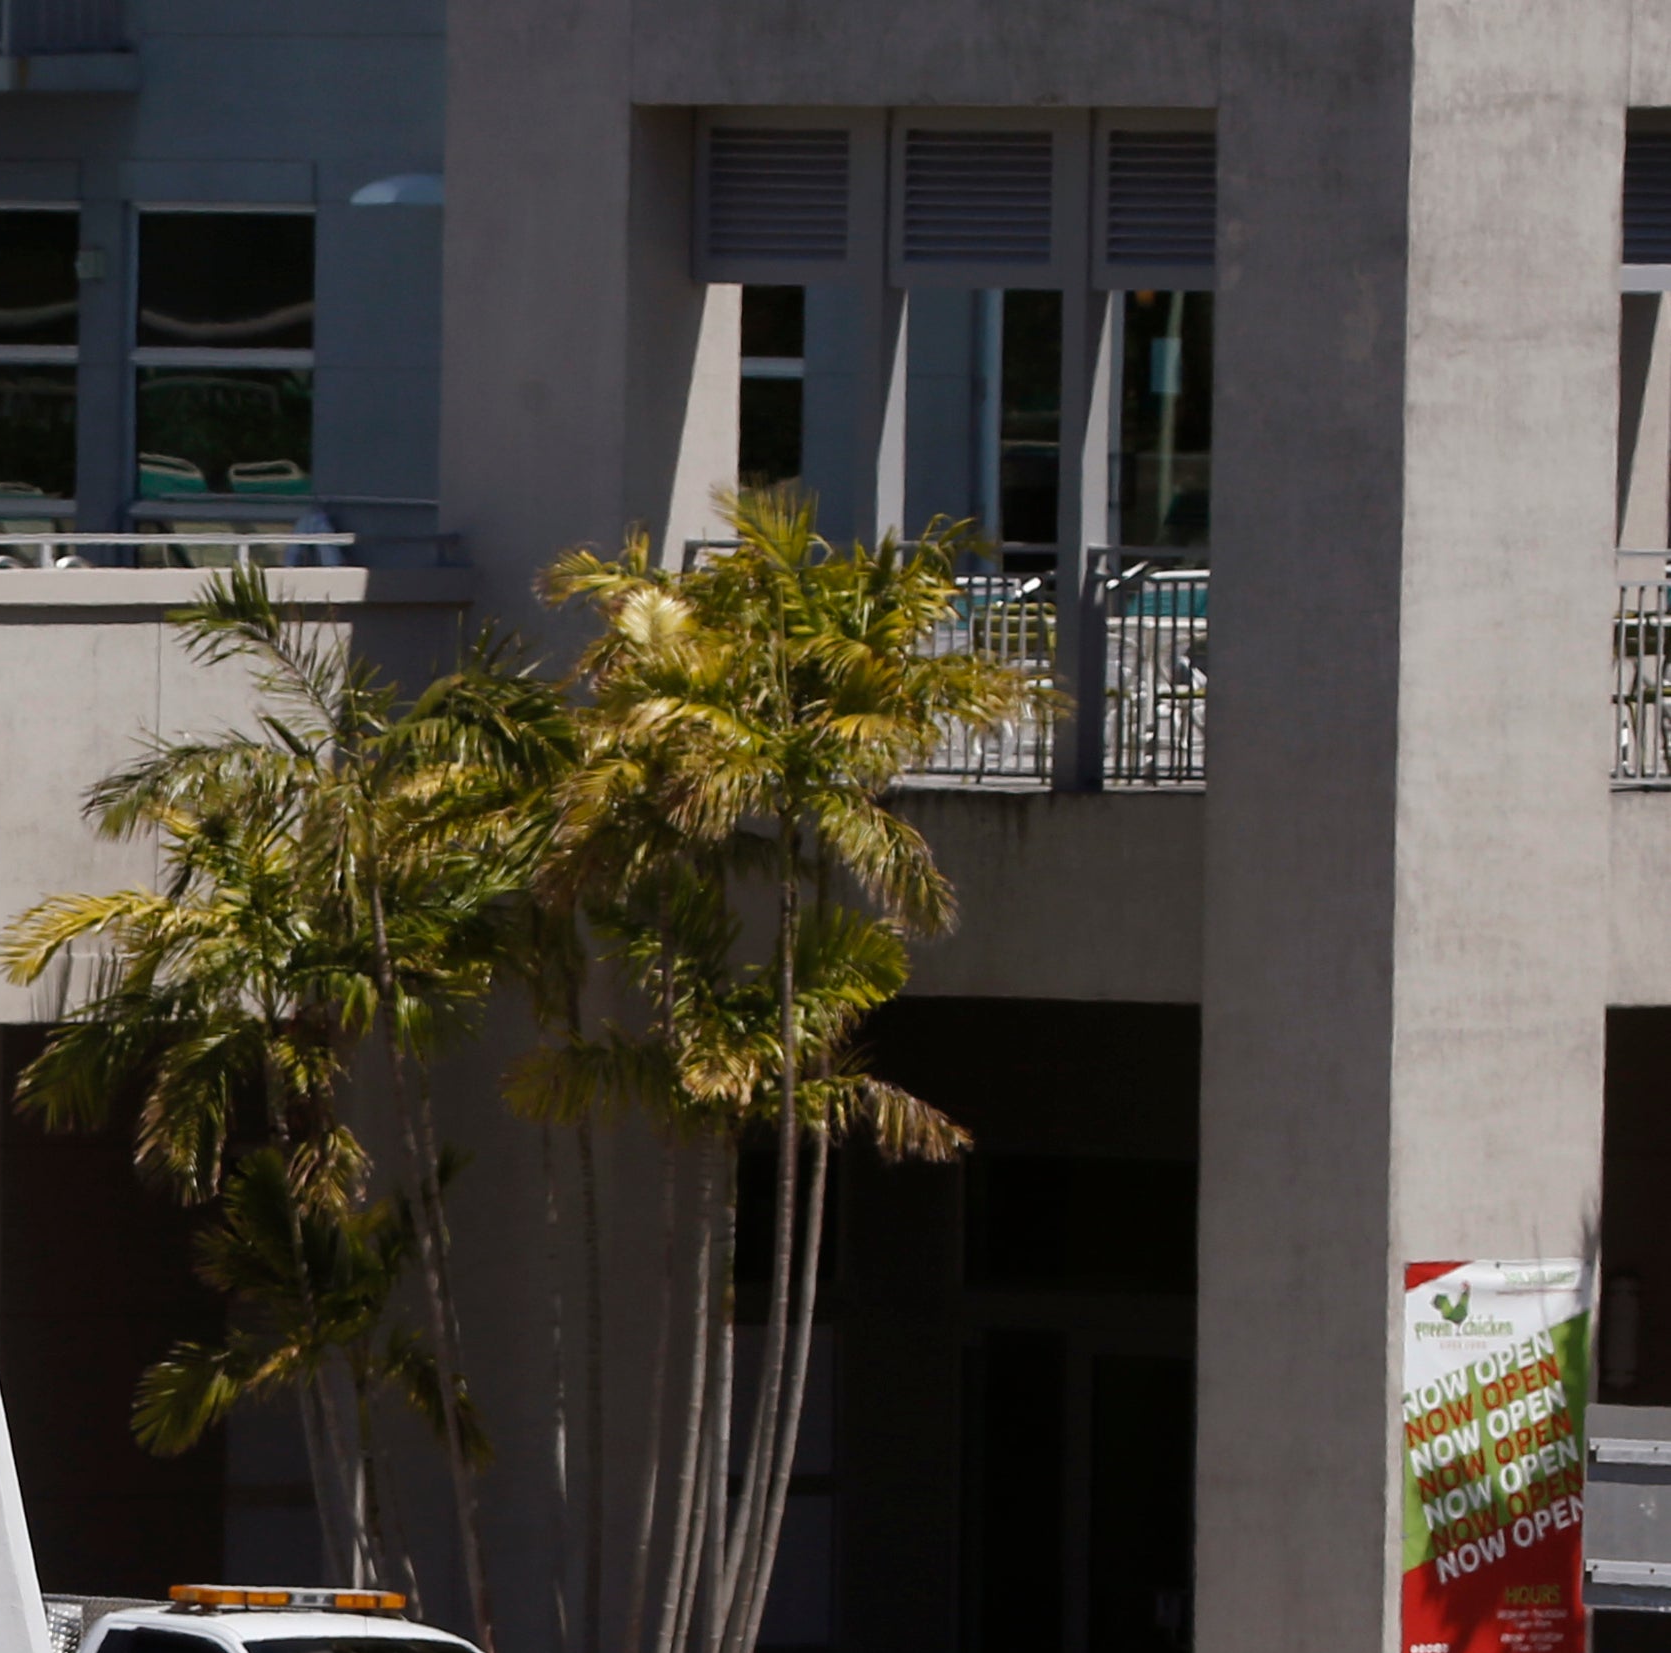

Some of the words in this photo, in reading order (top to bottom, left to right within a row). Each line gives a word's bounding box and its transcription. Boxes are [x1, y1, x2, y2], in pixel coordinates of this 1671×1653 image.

[1403, 1368, 1470, 1422] NOW
[1474, 1329, 1555, 1386] OPEN
[1404, 1395, 1473, 1448] NOW
[1482, 1355, 1562, 1411] OPEN
[1409, 1423, 1481, 1477] NOW
[1486, 1381, 1567, 1440] OPEN
[1417, 1450, 1486, 1503] NOW
[1494, 1407, 1573, 1466] OPEN
[1422, 1475, 1493, 1531] NOW
[1499, 1435, 1580, 1494] OPEN
[1430, 1503, 1499, 1556] NOW
[1506, 1464, 1584, 1520] OPEN
[1436, 1531, 1505, 1586] NOW
[1512, 1490, 1585, 1549] OPEN
[1505, 1584, 1560, 1605] HOURS
